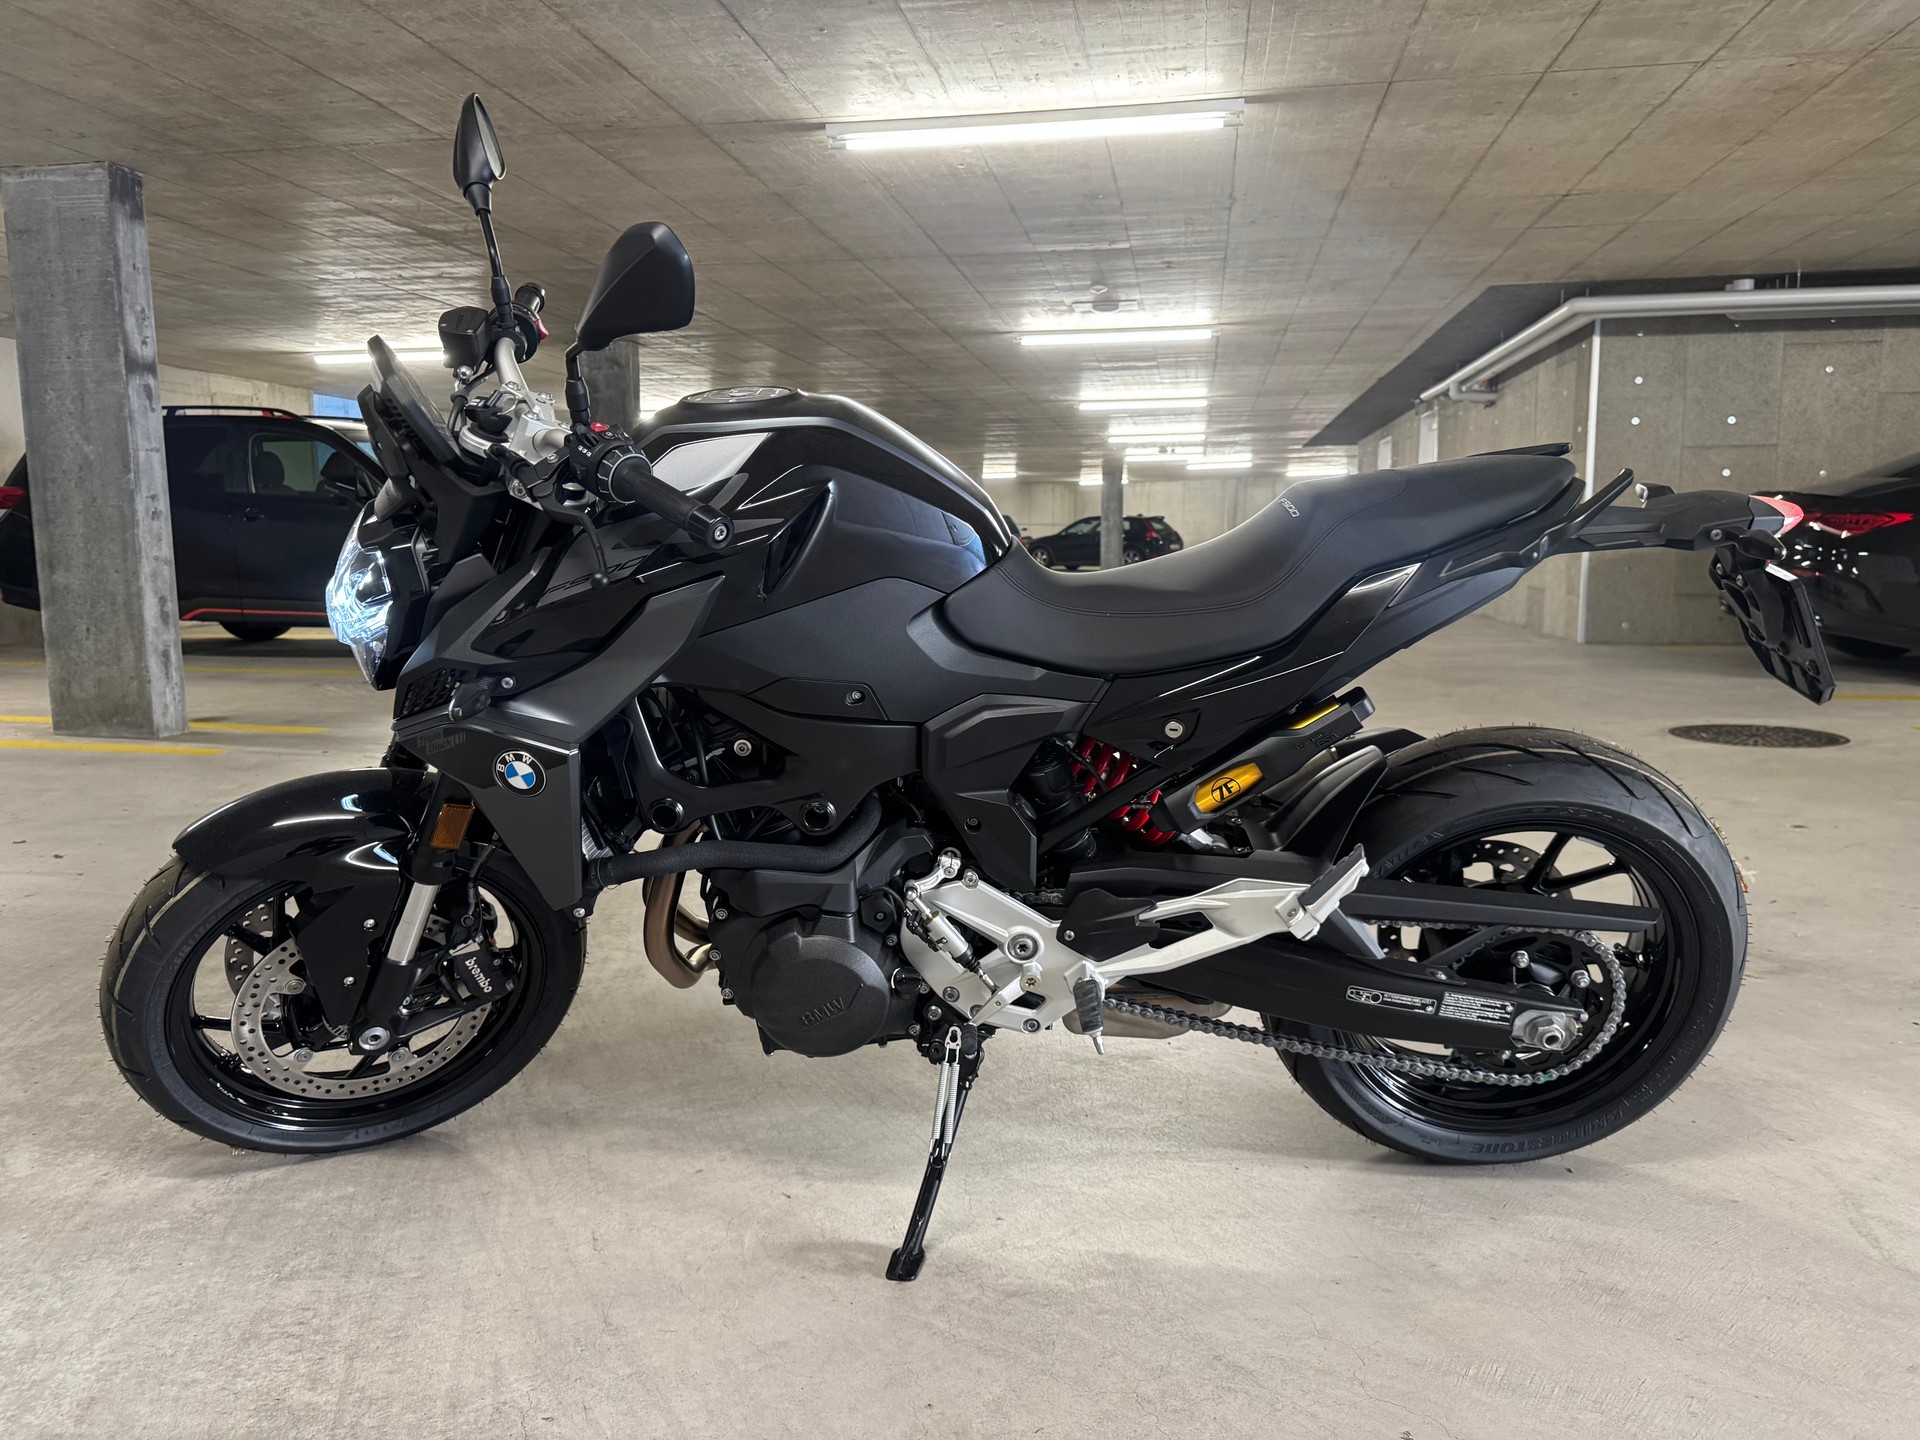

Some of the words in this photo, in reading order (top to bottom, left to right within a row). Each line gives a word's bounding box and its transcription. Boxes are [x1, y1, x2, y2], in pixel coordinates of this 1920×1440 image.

[497, 753, 533, 773] BMW
[1211, 779, 1240, 801] ZF
[465, 956, 493, 993] brembo
[801, 996, 845, 1025] BMW
